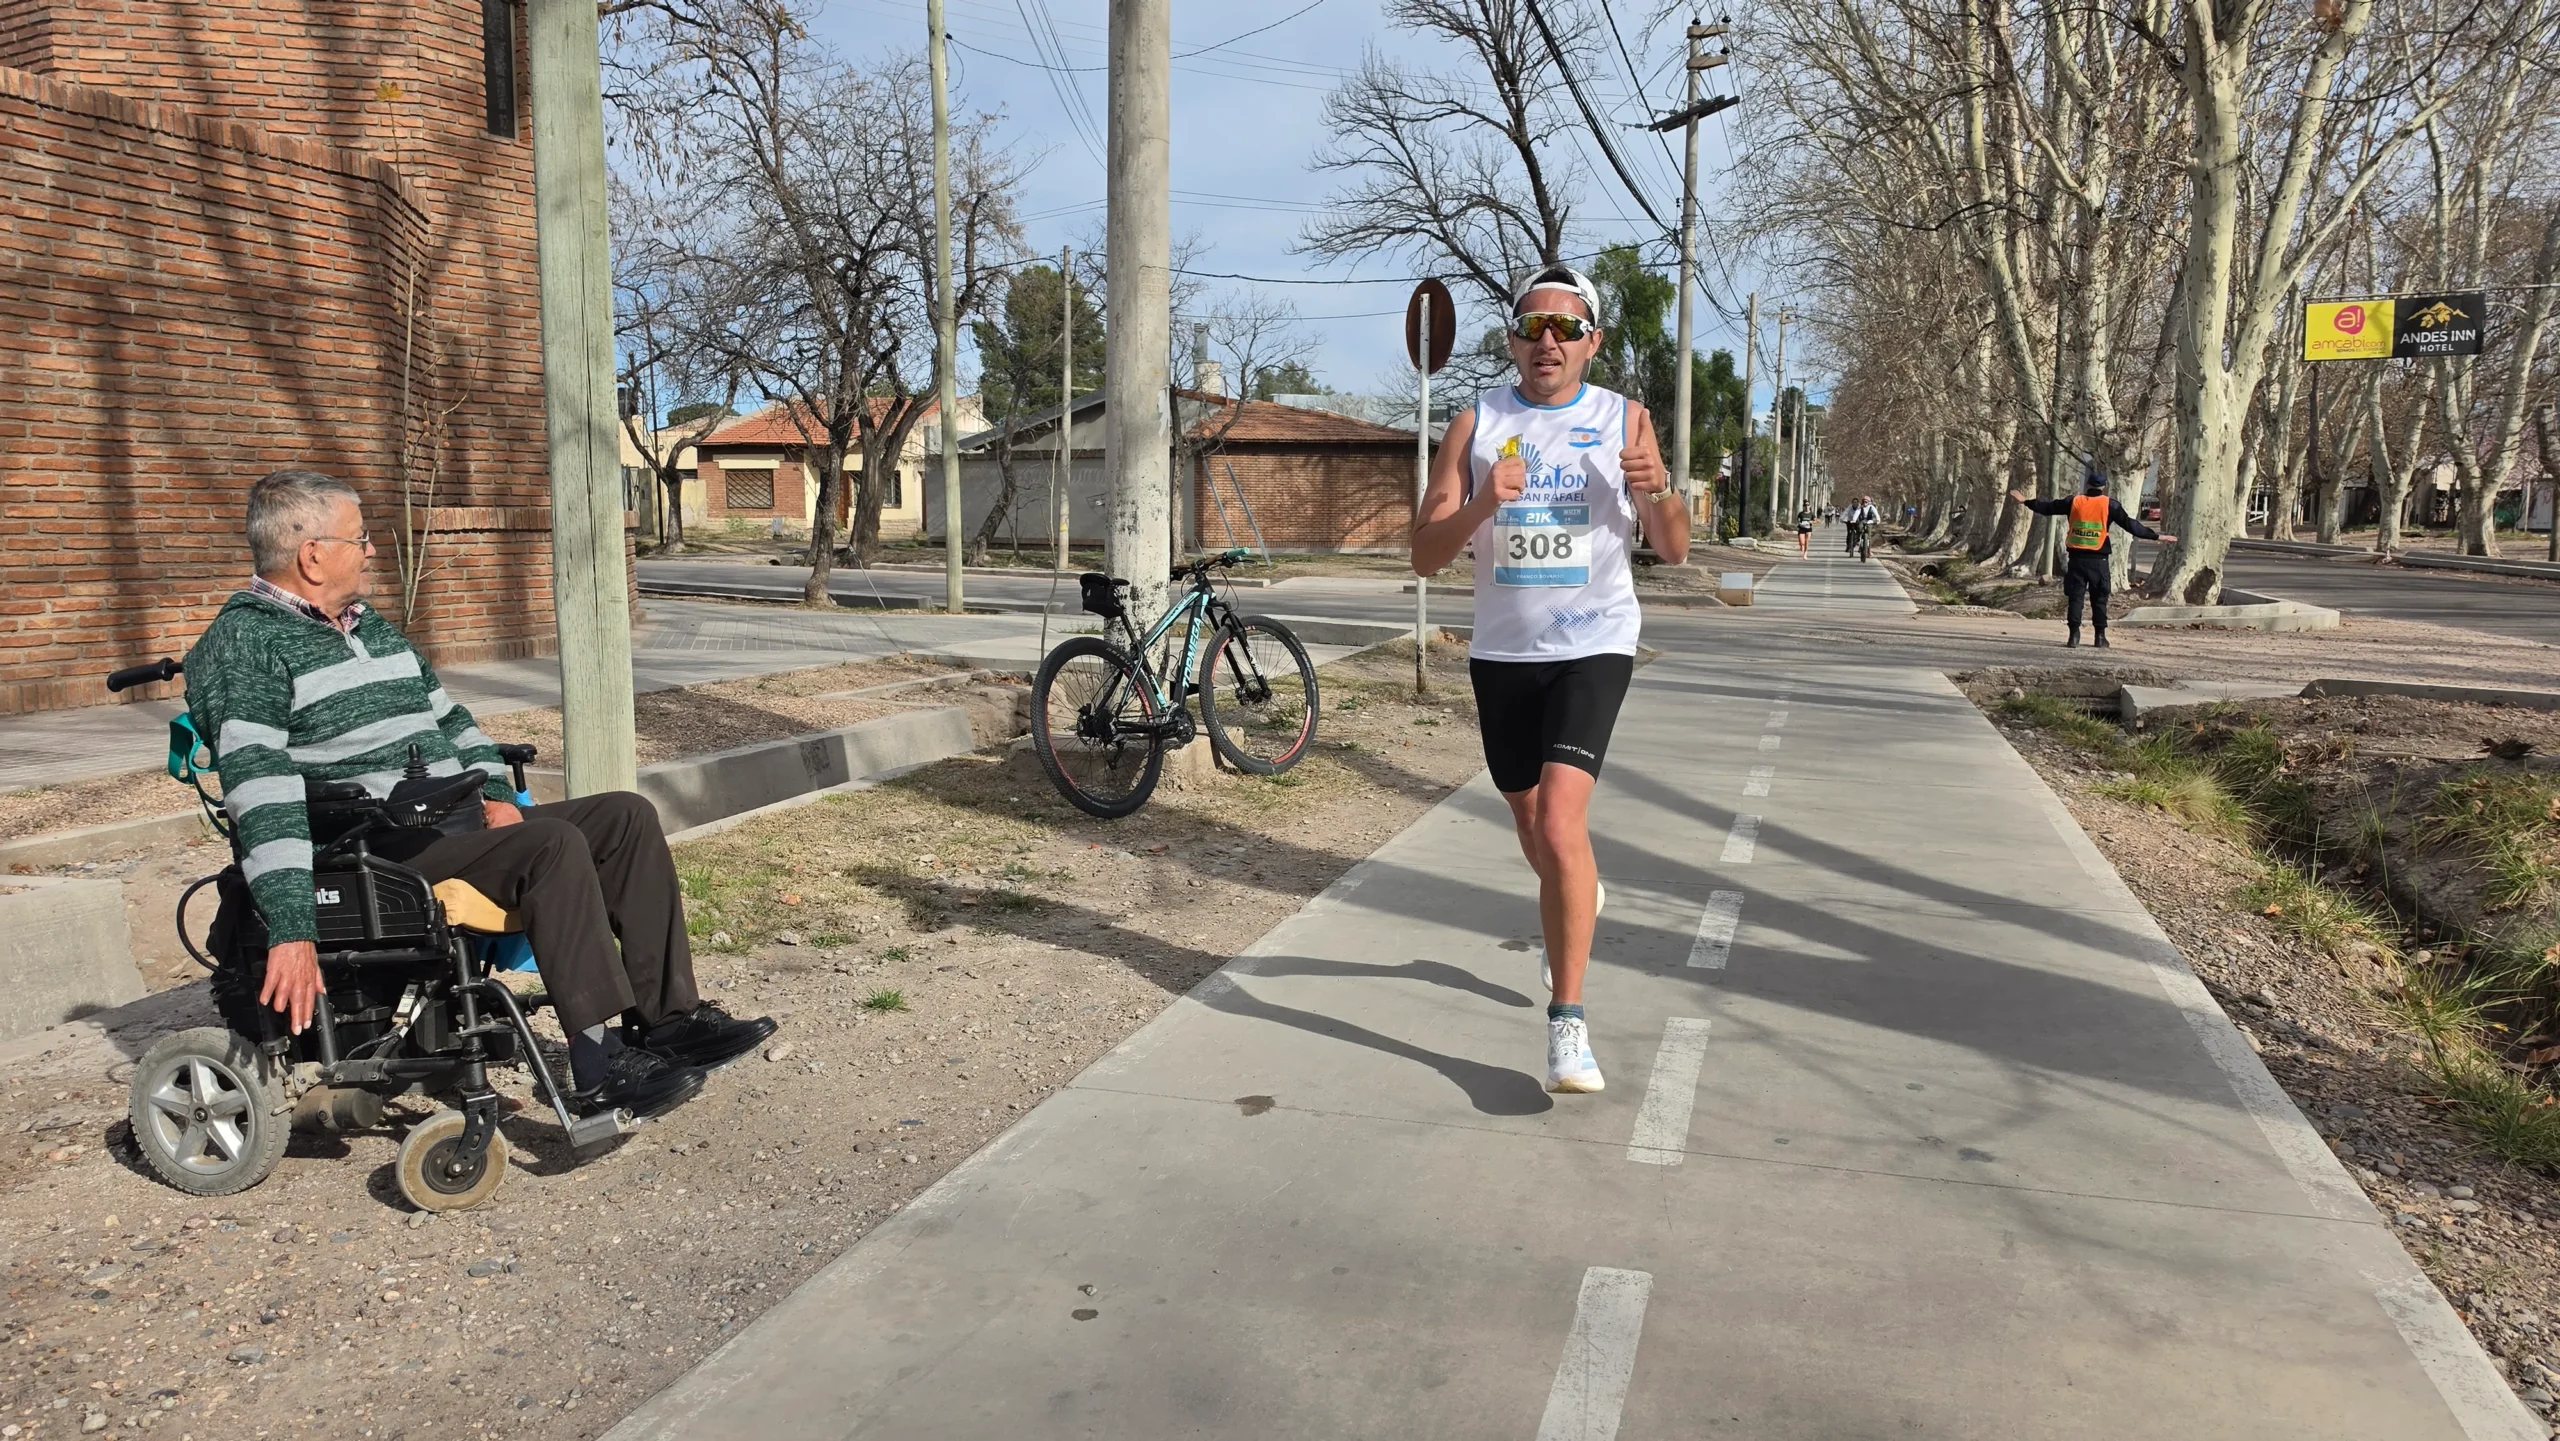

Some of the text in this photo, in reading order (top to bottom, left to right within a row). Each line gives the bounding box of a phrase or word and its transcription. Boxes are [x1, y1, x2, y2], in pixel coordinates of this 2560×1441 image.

[2311, 335, 2386, 350] amcabi.com
[2400, 329, 2476, 344] ANDES INN
[2420, 343, 2454, 352] HOTEL
[1525, 470, 1589, 490] RATON
[1517, 492, 1586, 502] SAN RAFAEL
[1525, 512, 1553, 524] 21K
[1509, 532, 1573, 560] 308
